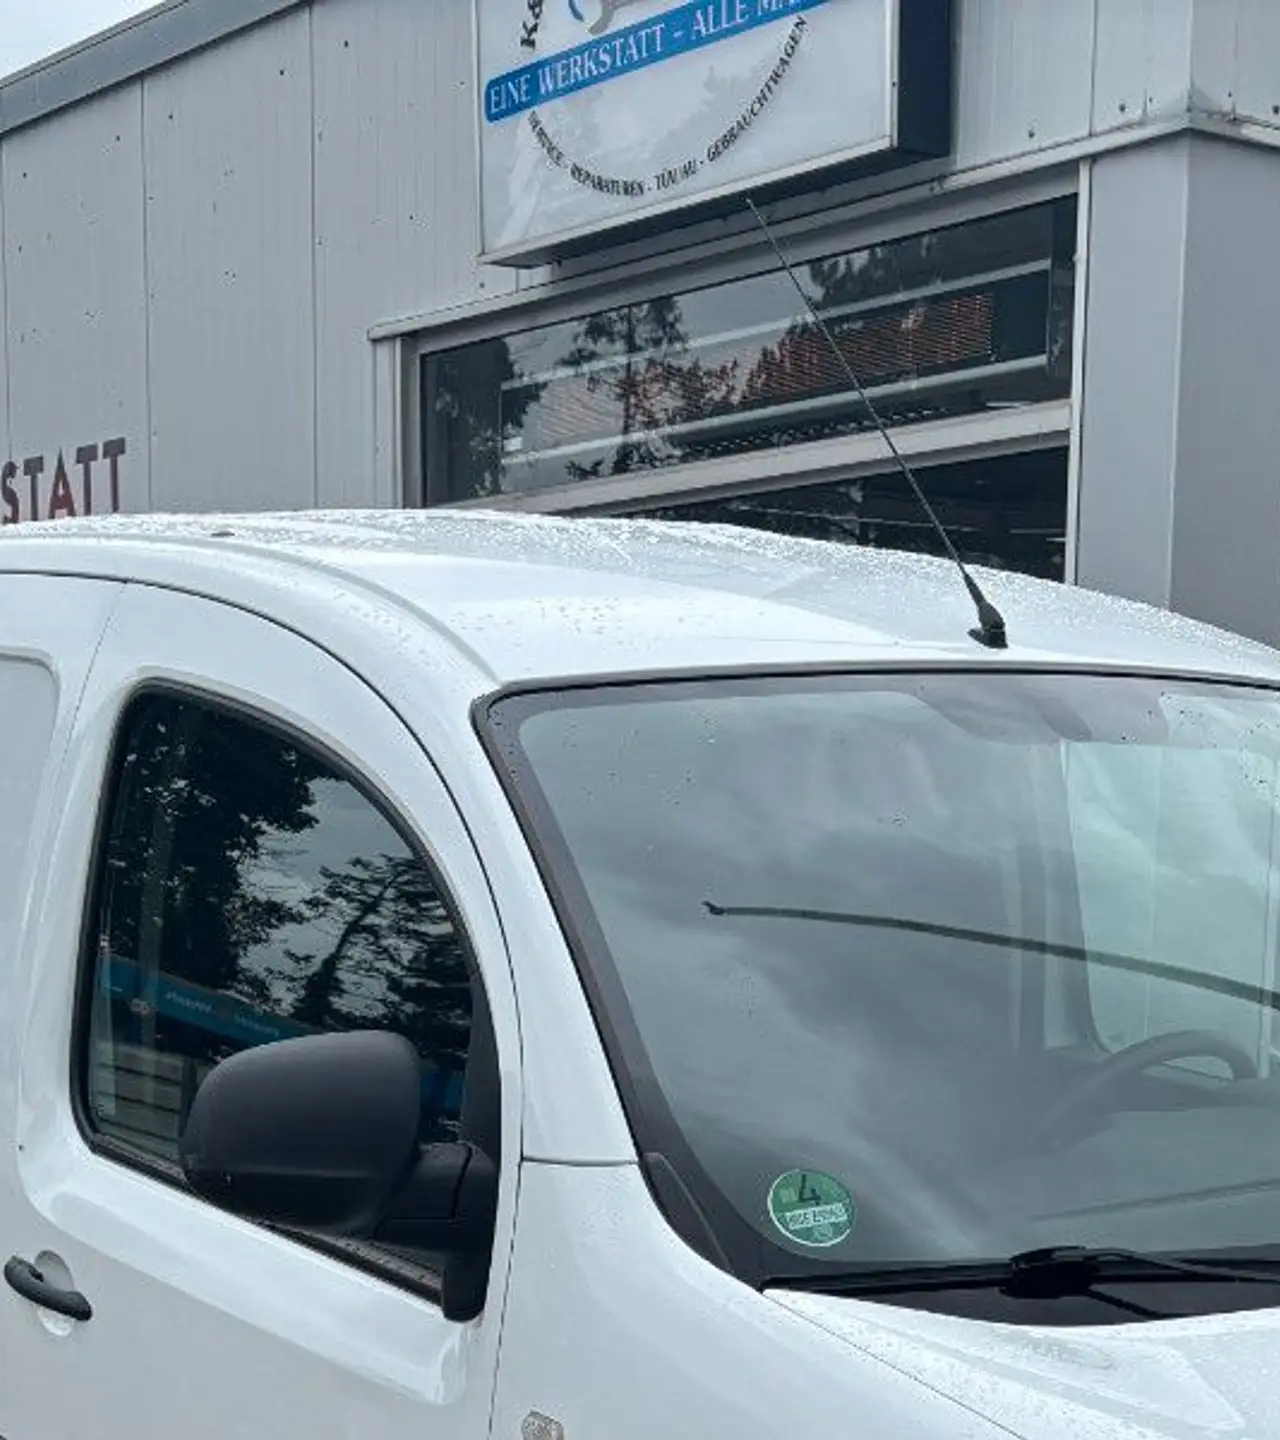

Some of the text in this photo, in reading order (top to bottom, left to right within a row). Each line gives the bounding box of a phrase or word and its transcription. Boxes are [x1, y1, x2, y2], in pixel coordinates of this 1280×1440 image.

[488, 73, 532, 115] EINE
[536, 22, 666, 97] WERKSTATT
[706, 14, 808, 163] GEBRAUCHTWAGEN
